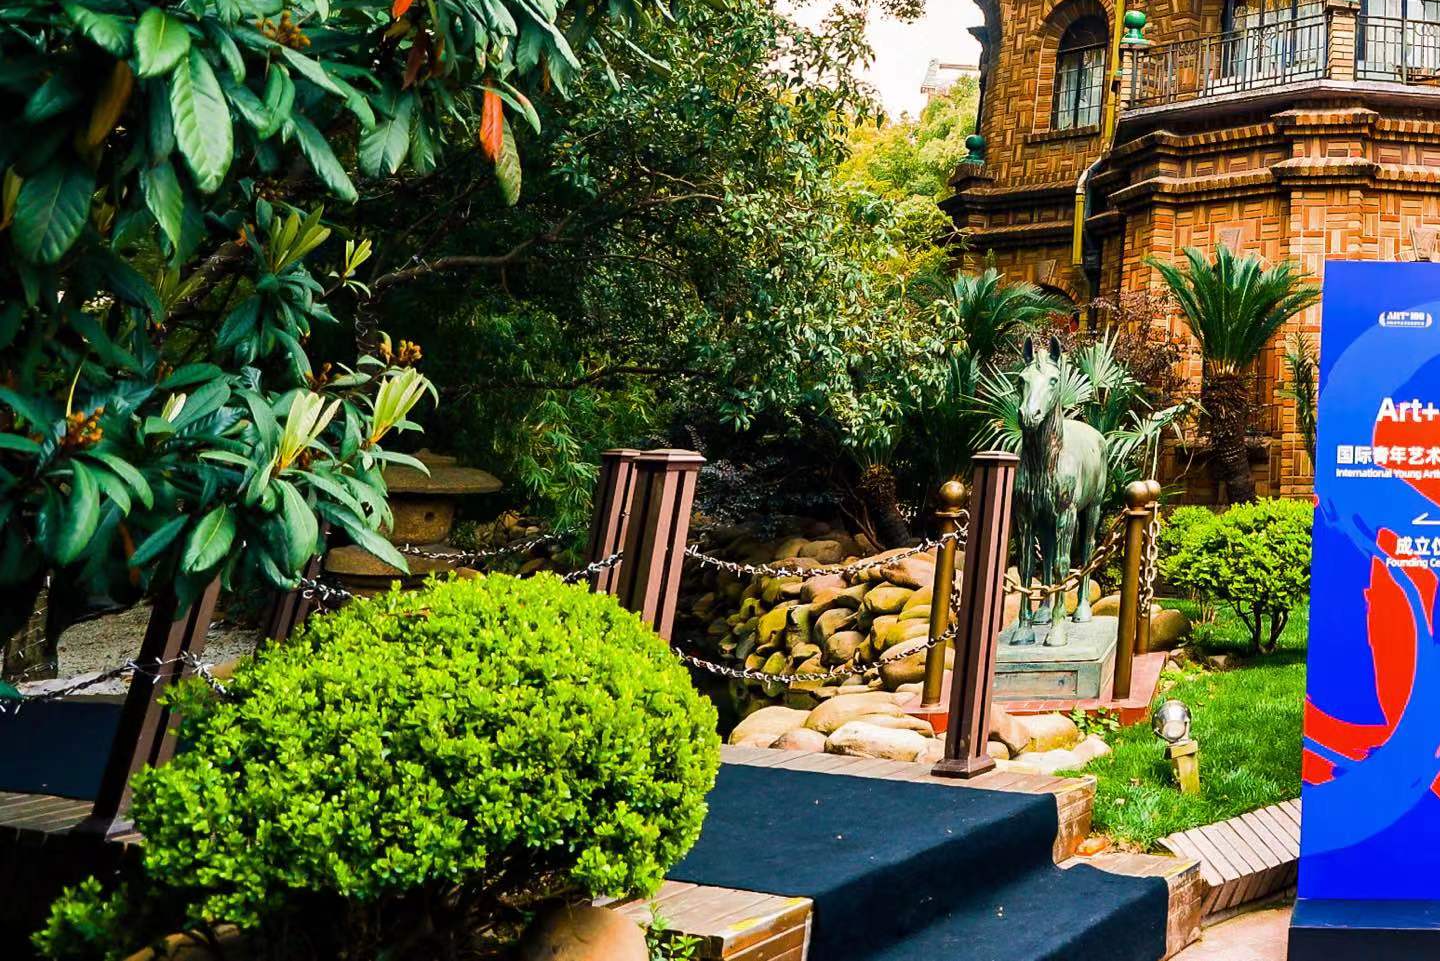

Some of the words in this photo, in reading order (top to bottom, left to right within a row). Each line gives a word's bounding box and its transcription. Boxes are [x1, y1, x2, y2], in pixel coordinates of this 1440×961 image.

[1336, 468, 1392, 478] International
[1393, 469, 1422, 480] Young
[1386, 557, 1428, 569] Founding
